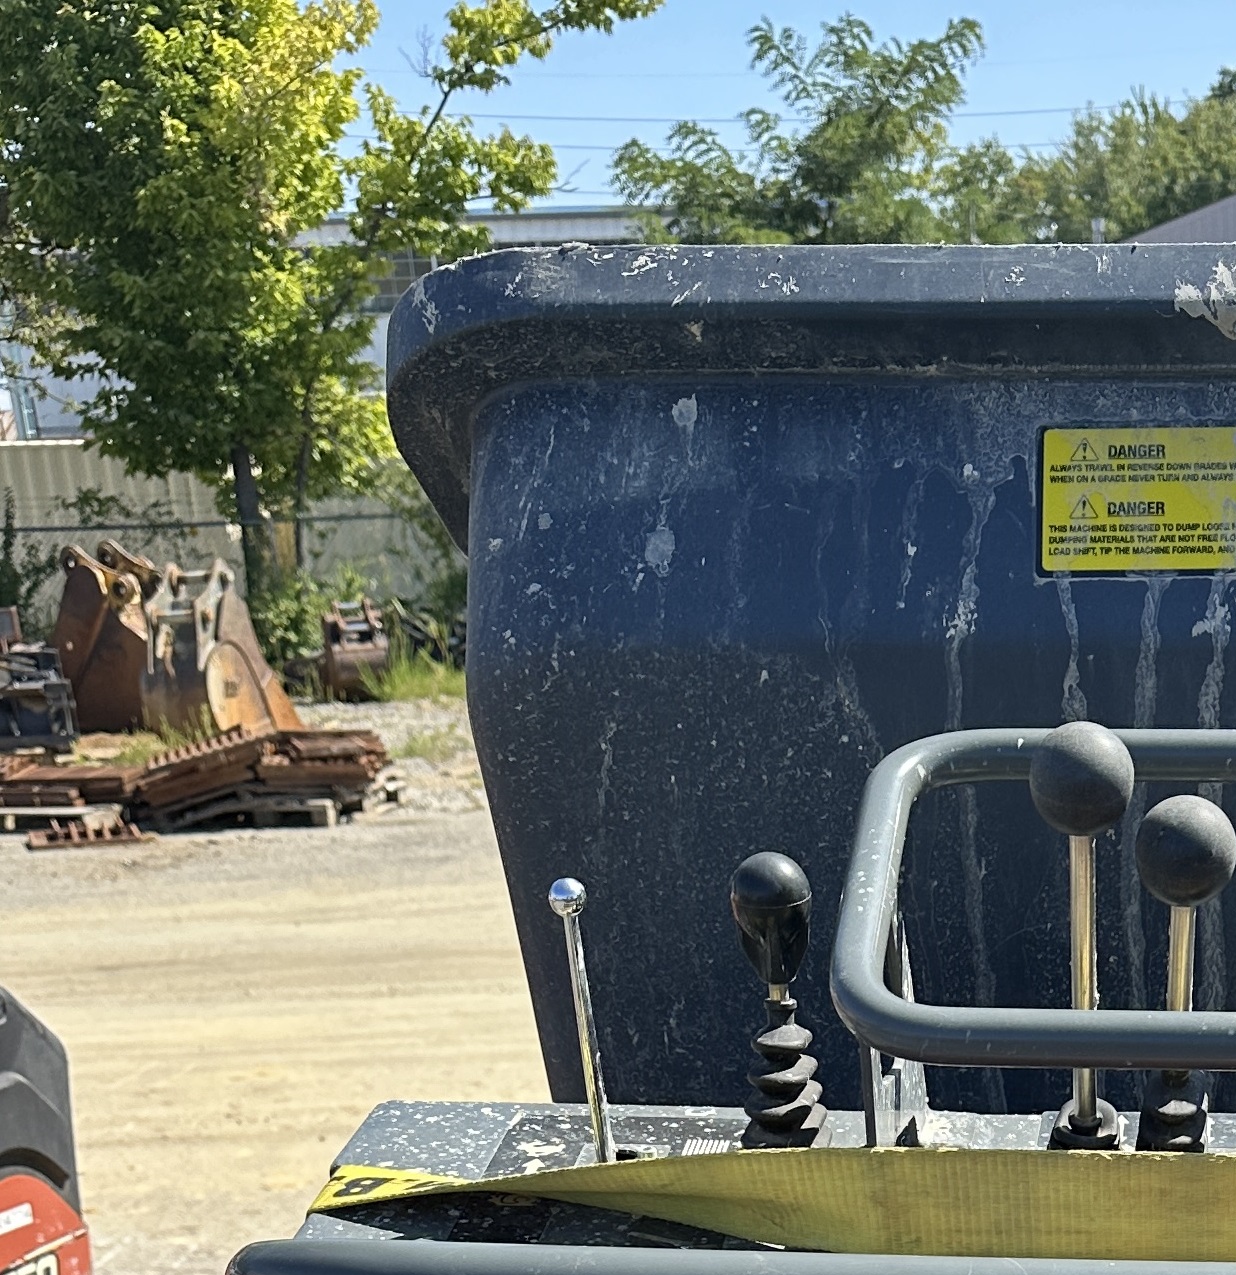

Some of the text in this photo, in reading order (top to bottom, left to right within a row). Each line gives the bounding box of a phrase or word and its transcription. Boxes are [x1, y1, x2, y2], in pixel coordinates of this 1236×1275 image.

[1108, 444, 1166, 459] DANGER
[1050, 464, 1083, 472] ALWAYS
[1166, 463, 1192, 471] DOWN
[1050, 475, 1074, 483] WHEN
[1201, 473, 1233, 481] ALWAYS
[1108, 501, 1165, 516] DANGER
[1069, 524, 1107, 532] MACHINE
[1109, 524, 1117, 532] IS
[1162, 523, 1174, 531] TO
[1176, 523, 1200, 531] DUMP
[1090, 535, 1135, 543] MATERIALS
[1137, 535, 1158, 543] THAT
[1159, 534, 1176, 542] ARE
[1178, 534, 1195, 542] NOT
[1049, 547, 1071, 555] LOAD
[1099, 546, 1112, 554] TIP
[1114, 546, 1130, 554] THE
[1132, 546, 1170, 554] MACHINE
[1172, 545, 1216, 555] FORWARD,
